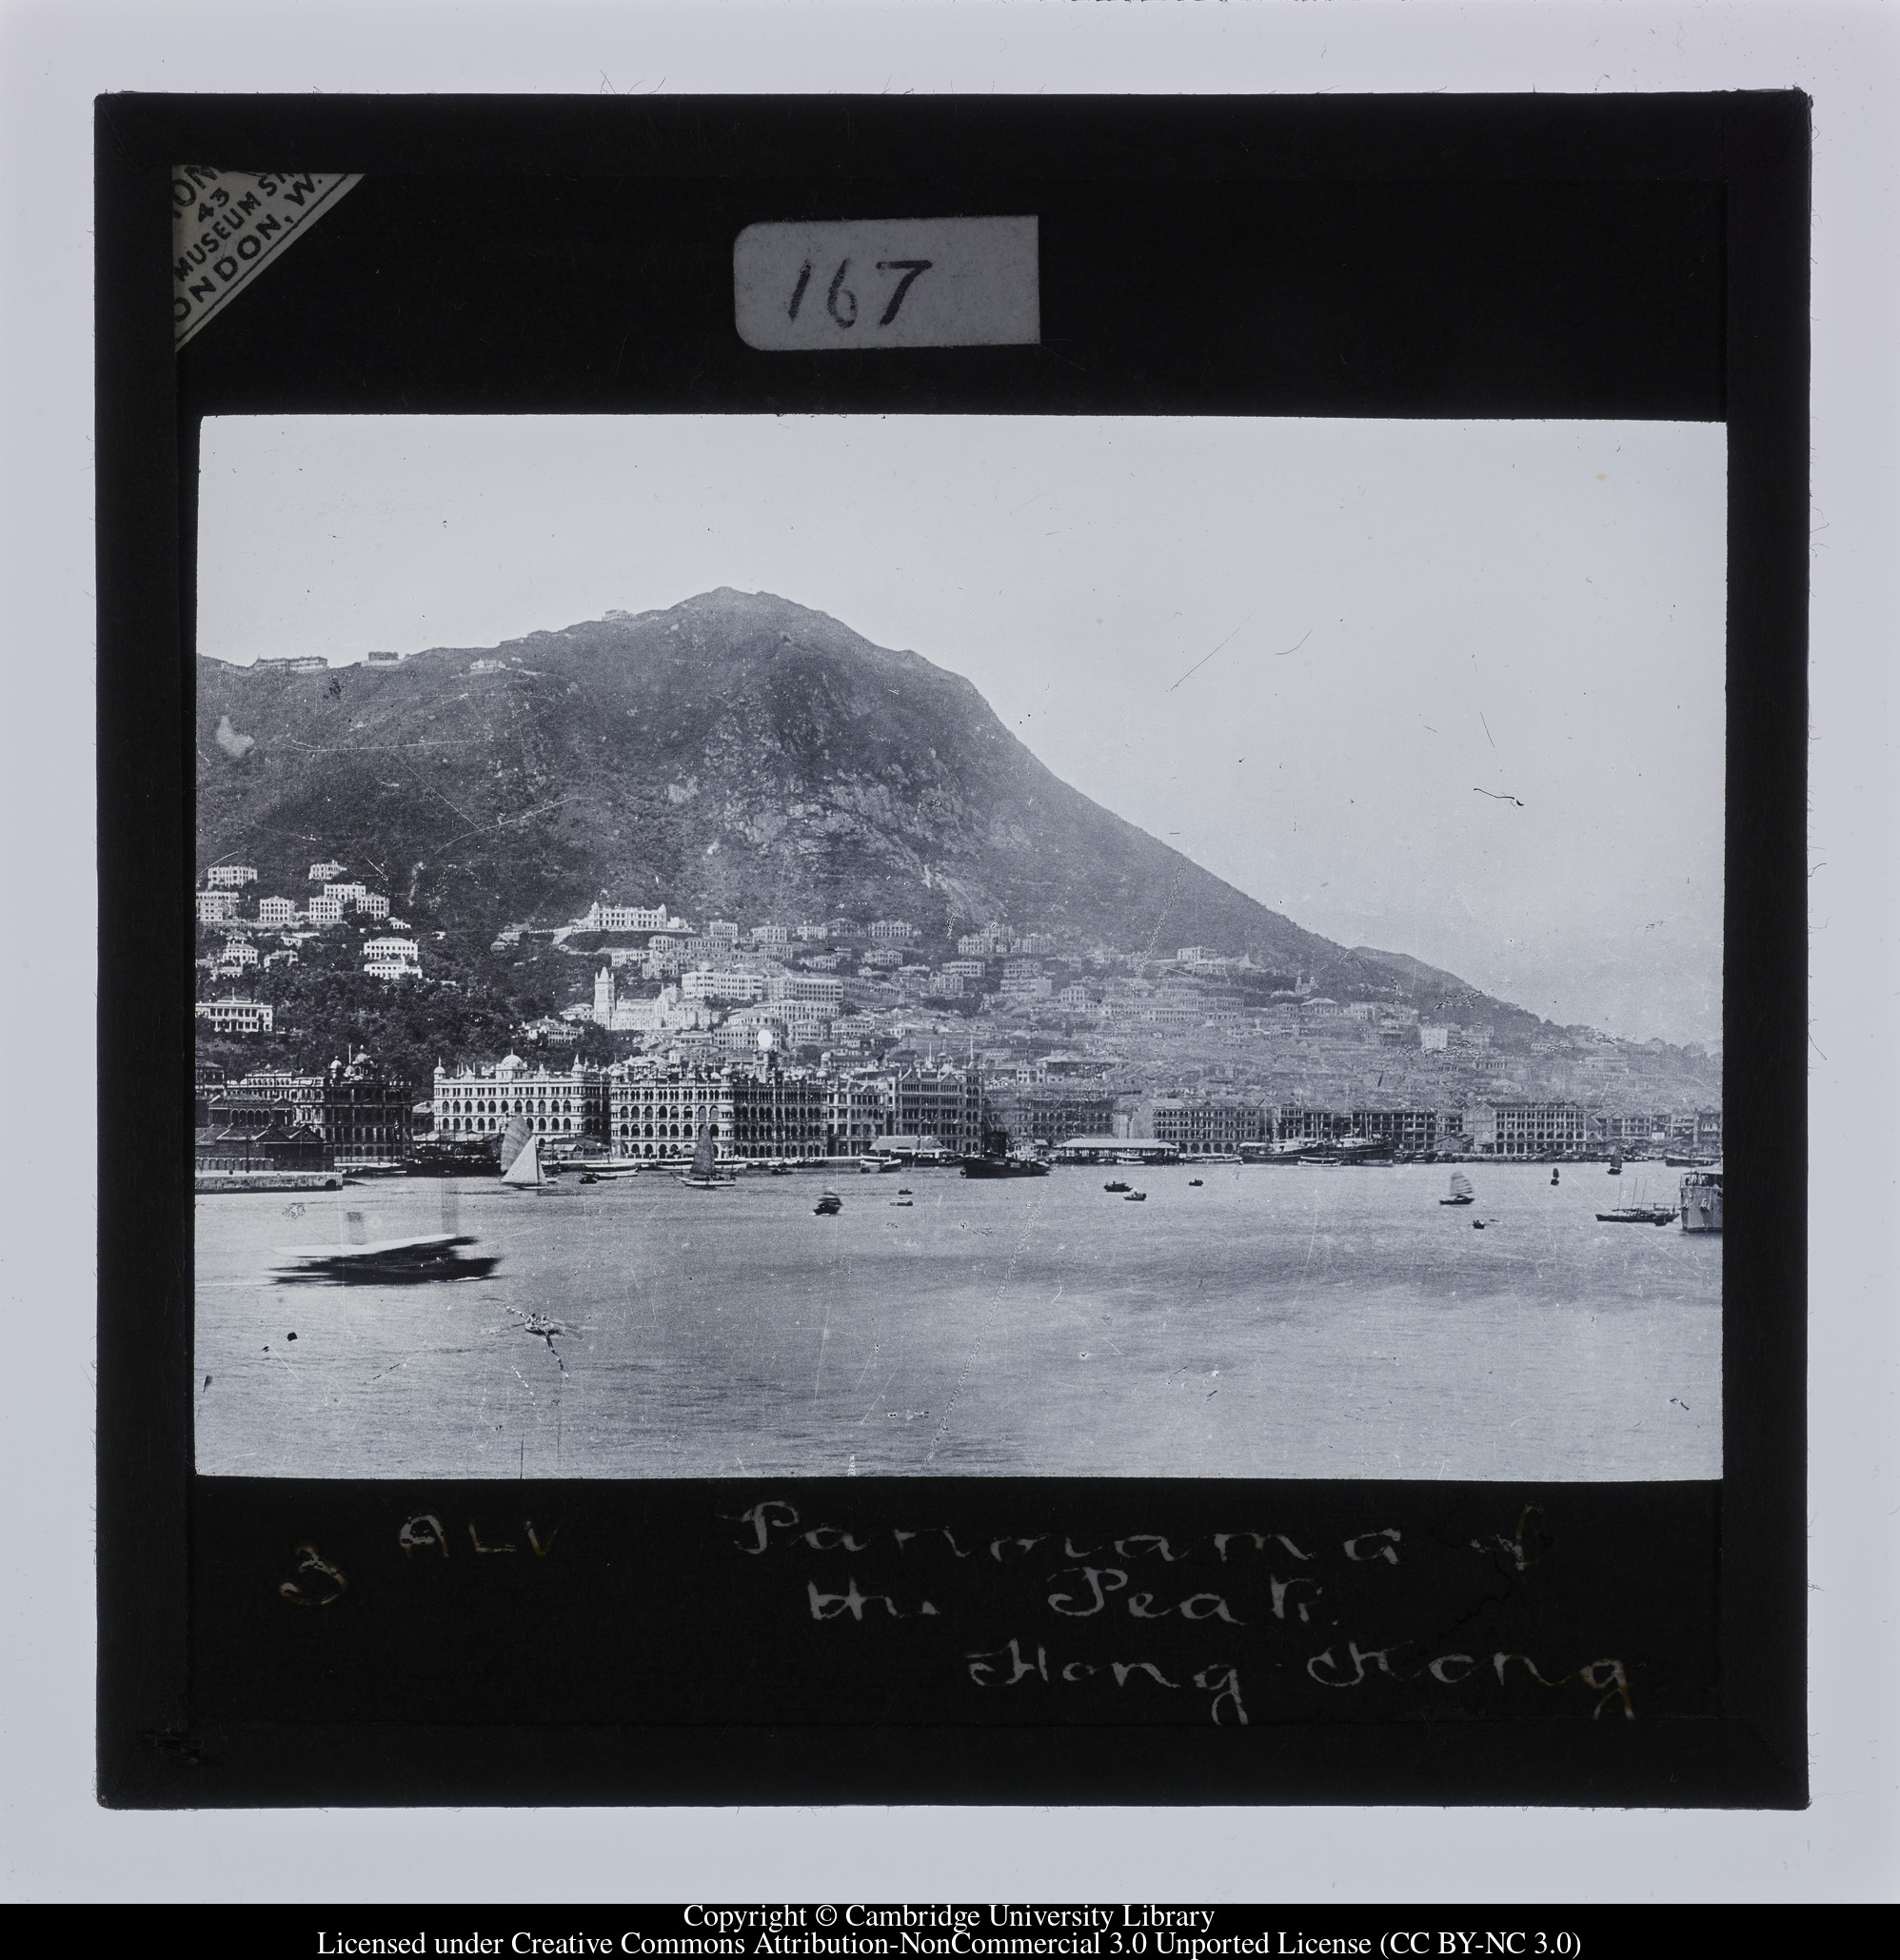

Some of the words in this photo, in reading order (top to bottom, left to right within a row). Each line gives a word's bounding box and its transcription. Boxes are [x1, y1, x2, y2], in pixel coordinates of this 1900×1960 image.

[172, 166, 218, 219] ON
[197, 187, 229, 223] 43
[174, 190, 262, 282] MUSEUM
[174, 213, 294, 323] ONDON,
[787, 259, 933, 328] 167
[963, 1637, 1249, 1726] Hong
[1306, 1639, 1635, 1721] Kong
